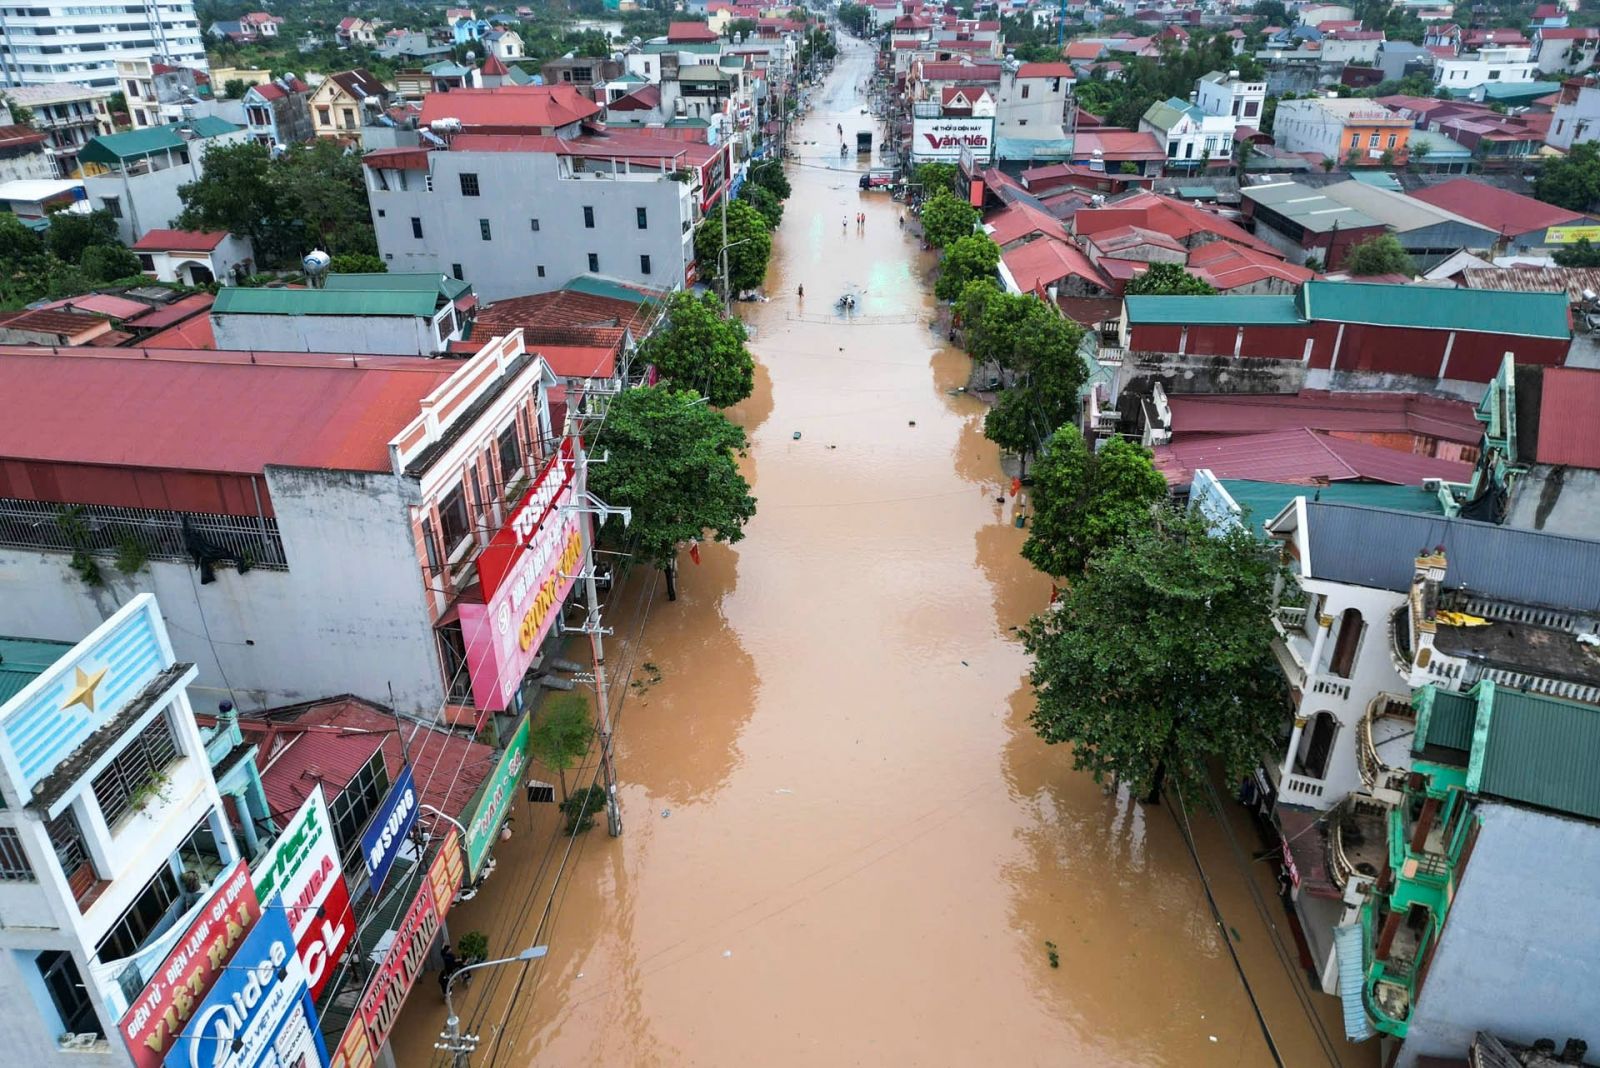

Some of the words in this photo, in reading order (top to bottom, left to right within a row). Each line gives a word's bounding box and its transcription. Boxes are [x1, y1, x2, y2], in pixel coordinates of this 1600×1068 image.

[512, 450, 567, 545] TOSHIBA
[255, 806, 318, 905] erfect
[365, 789, 414, 877] MSUNG
[286, 855, 335, 934] SHIBA
[127, 1005, 151, 1040] ĐIỆN
[150, 982, 162, 1009] TỬ
[165, 954, 189, 986] ĐIỆN
[185, 925, 210, 959] LẠNH
[212, 901, 229, 922] GIA
[226, 871, 247, 905] DỤNG
[144, 965, 205, 1053] VIỆT
[207, 902, 251, 971] HẢI
[302, 919, 346, 989] CL
[190, 940, 287, 1068] Midea
